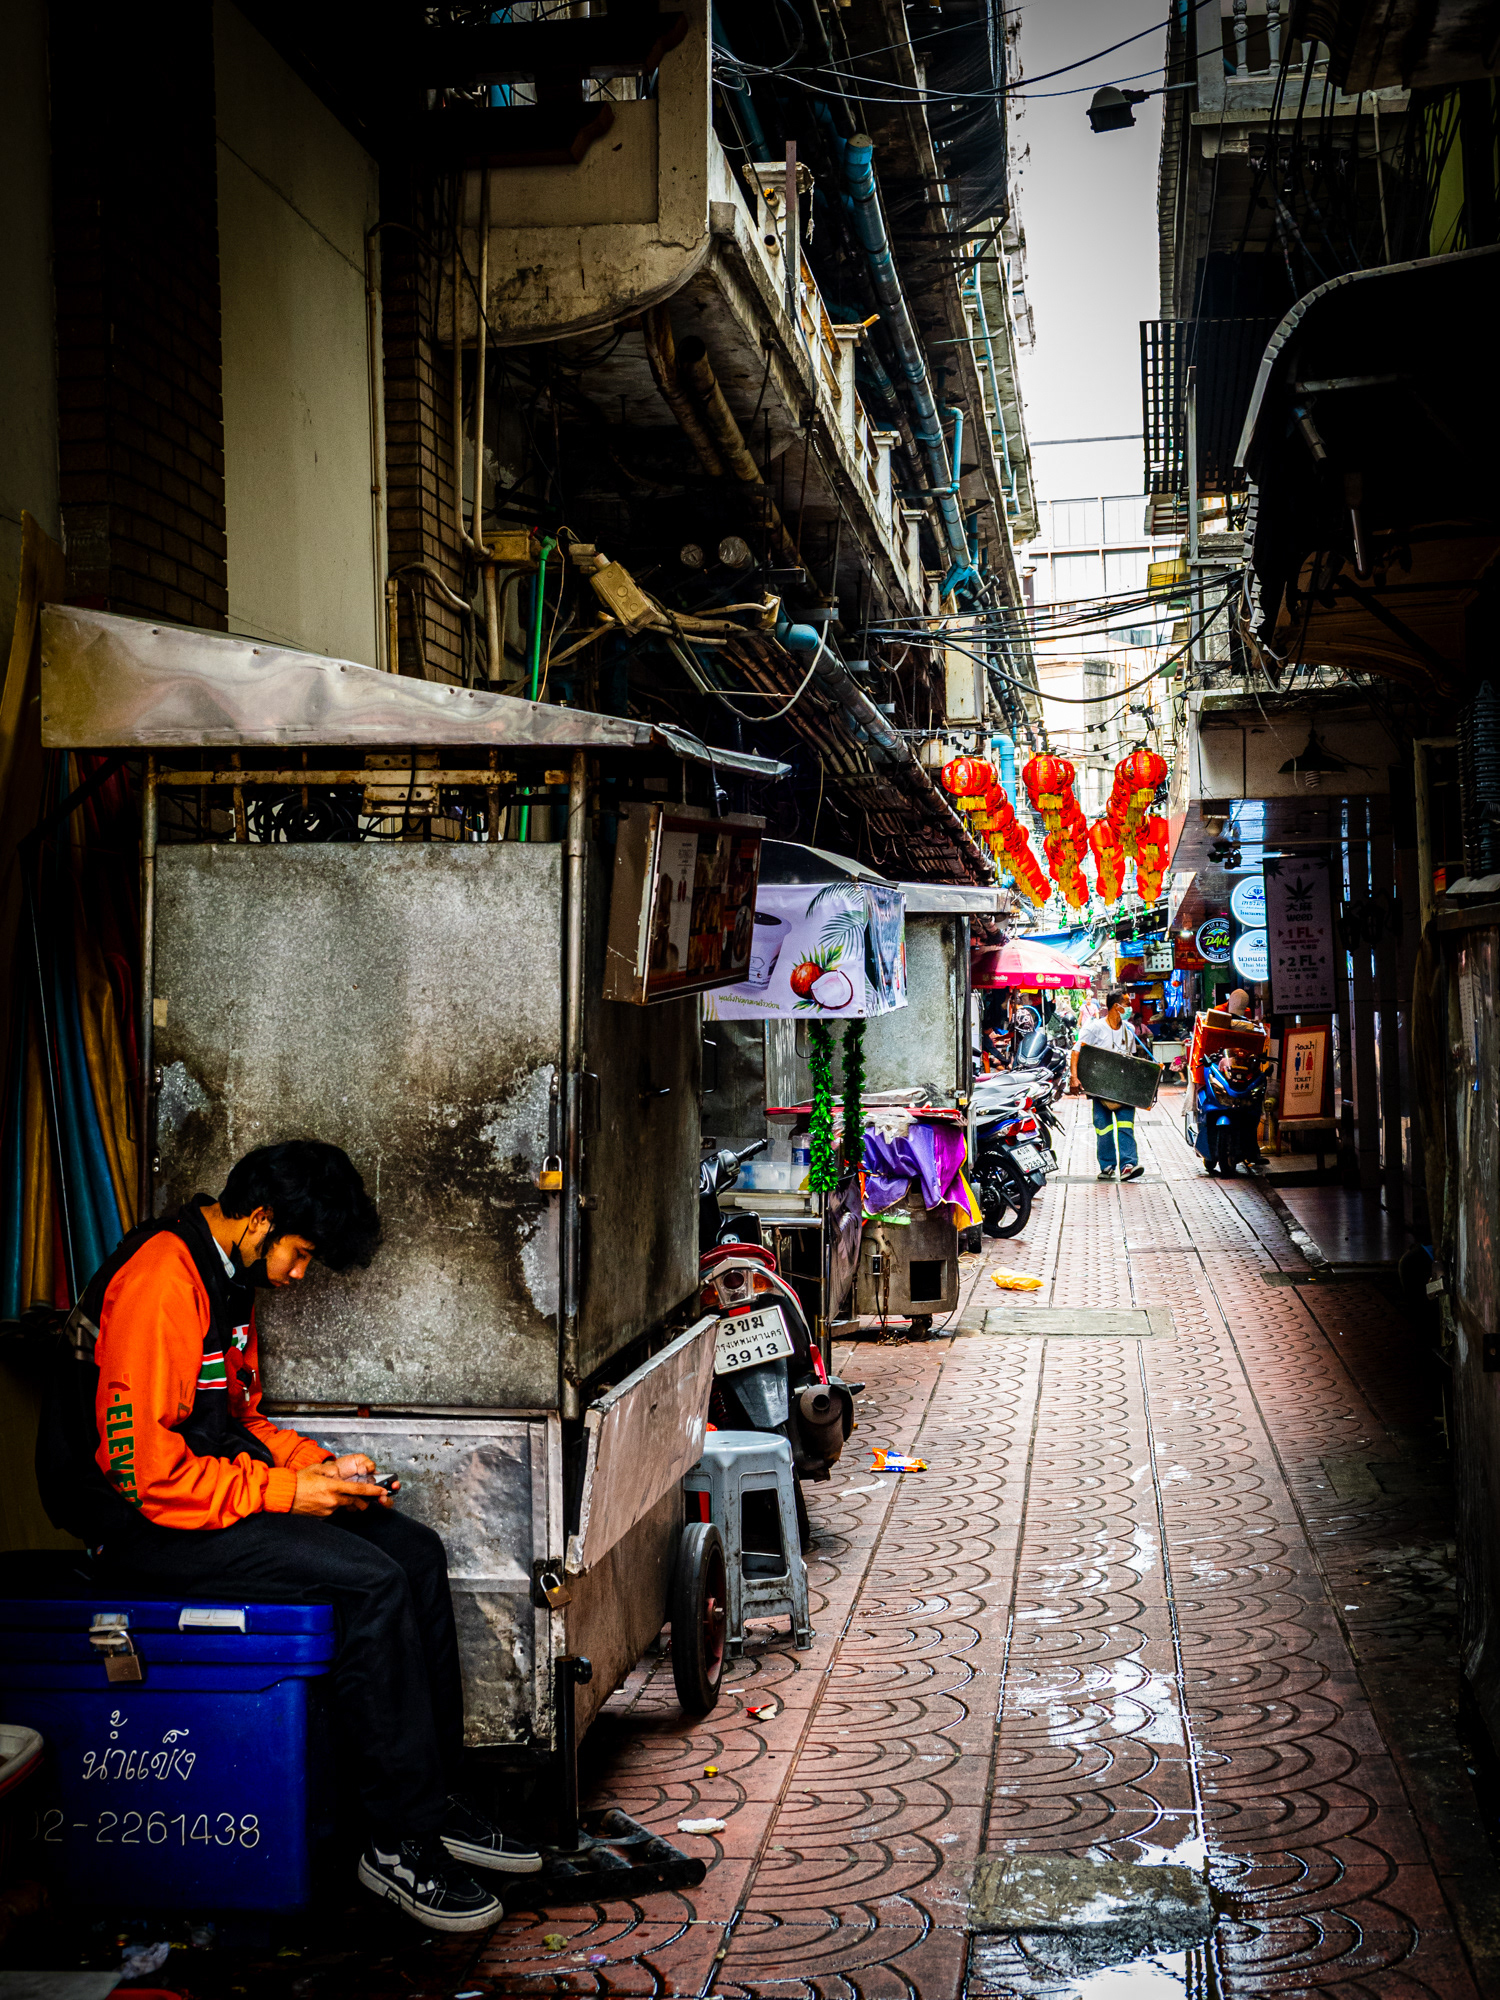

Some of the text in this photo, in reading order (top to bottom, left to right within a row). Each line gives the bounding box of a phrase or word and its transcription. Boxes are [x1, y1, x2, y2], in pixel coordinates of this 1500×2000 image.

[1288, 927, 1314, 938] 1 FL
[1288, 955, 1316, 966] 2 FL
[726, 1342, 779, 1367] 3913
[82, 1709, 196, 1781] น้ำแข็ง
